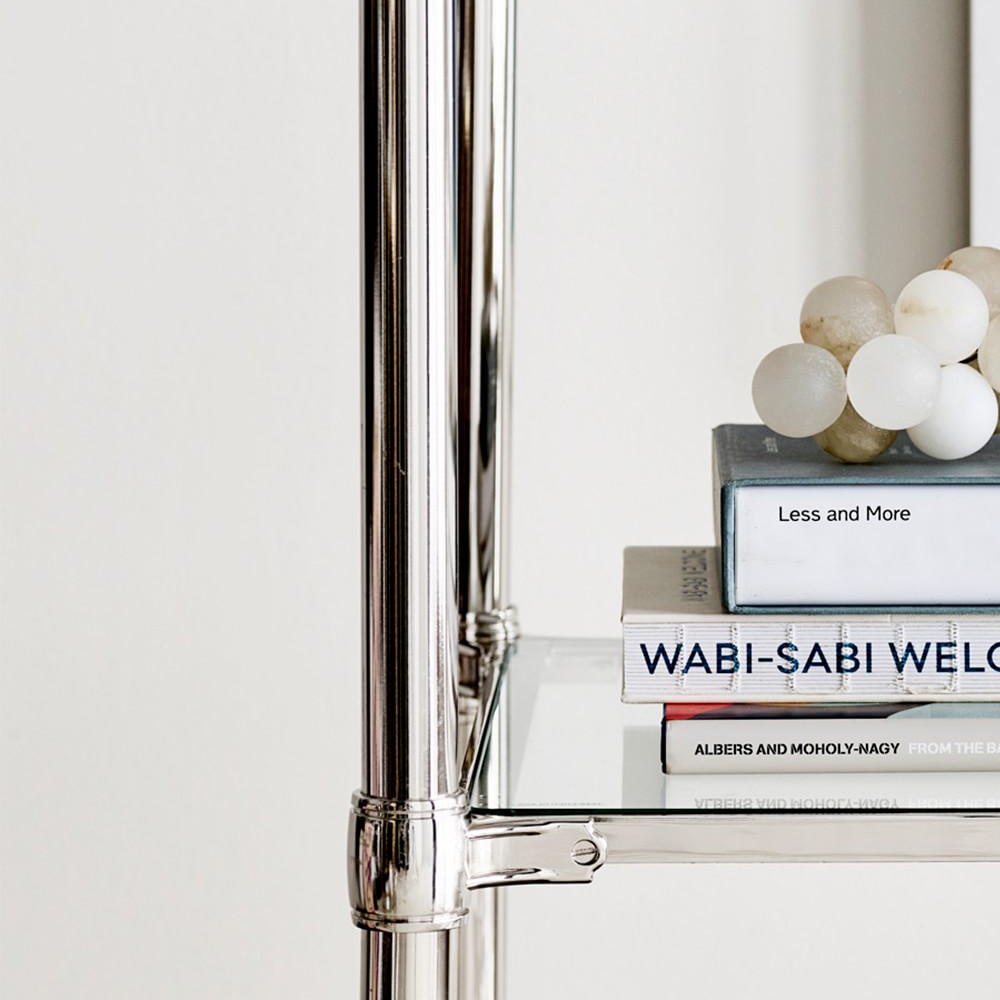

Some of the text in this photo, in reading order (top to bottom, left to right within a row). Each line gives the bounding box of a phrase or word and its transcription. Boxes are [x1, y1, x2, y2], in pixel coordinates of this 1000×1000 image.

[778, 506, 911, 522] Less and More
[640, 641, 872, 675] WABI-SABI
[694, 743, 753, 756] ALBERS
[756, 743, 788, 756] AND
[790, 742, 900, 756] MOHOLY-NAGY
[908, 742, 952, 754] FROM
[954, 742, 984, 754] THE
